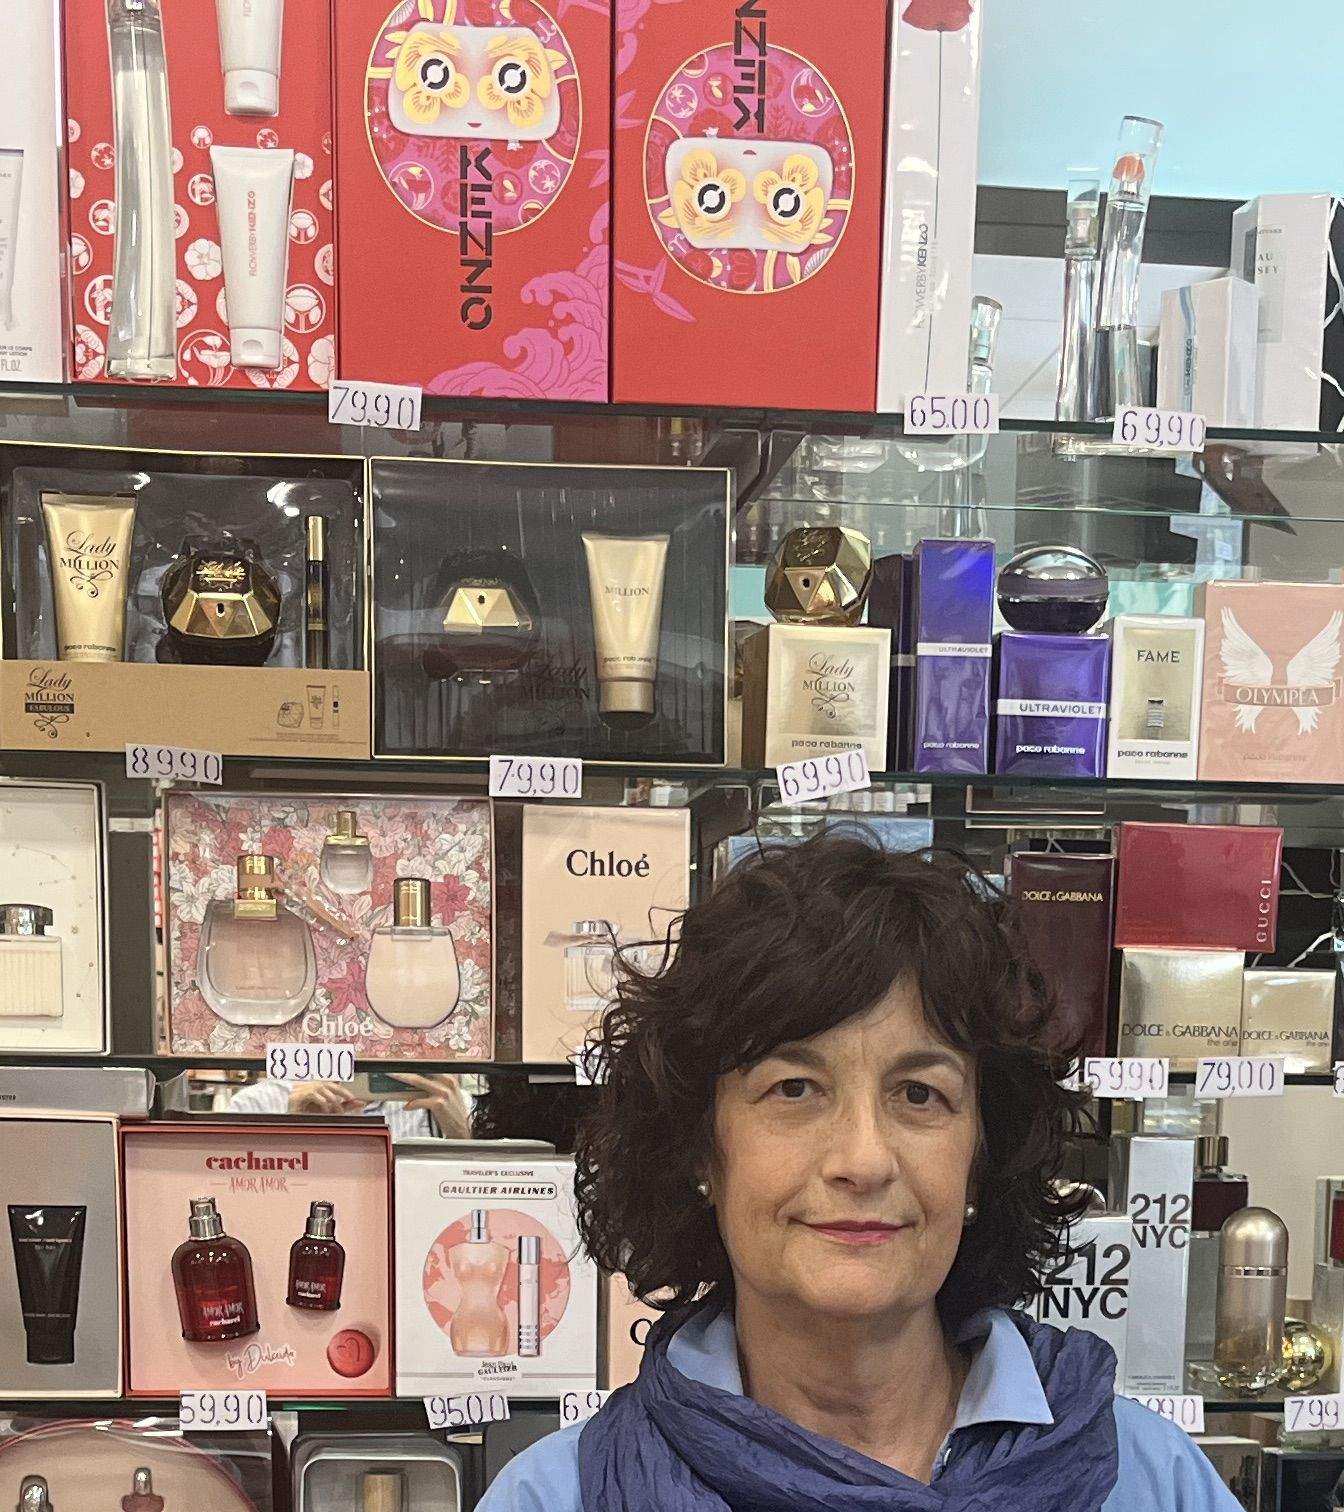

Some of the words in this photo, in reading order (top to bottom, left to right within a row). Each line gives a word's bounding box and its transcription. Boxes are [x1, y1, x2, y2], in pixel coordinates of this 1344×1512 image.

[459, 144, 493, 331] KENZO
[59, 556, 120, 573] MILLION
[1136, 649, 1180, 663] FAME
[802, 679, 856, 694] MILLION
[1019, 701, 1102, 717] ULTRAVIOLET
[566, 849, 650, 879] Chloé
[1256, 878, 1273, 942] GUCCI
[206, 1152, 308, 1170] cacharel
[1130, 1193, 1189, 1224] 212
[1131, 1224, 1188, 1249] NYC
[1042, 1286, 1128, 1320] NYC
